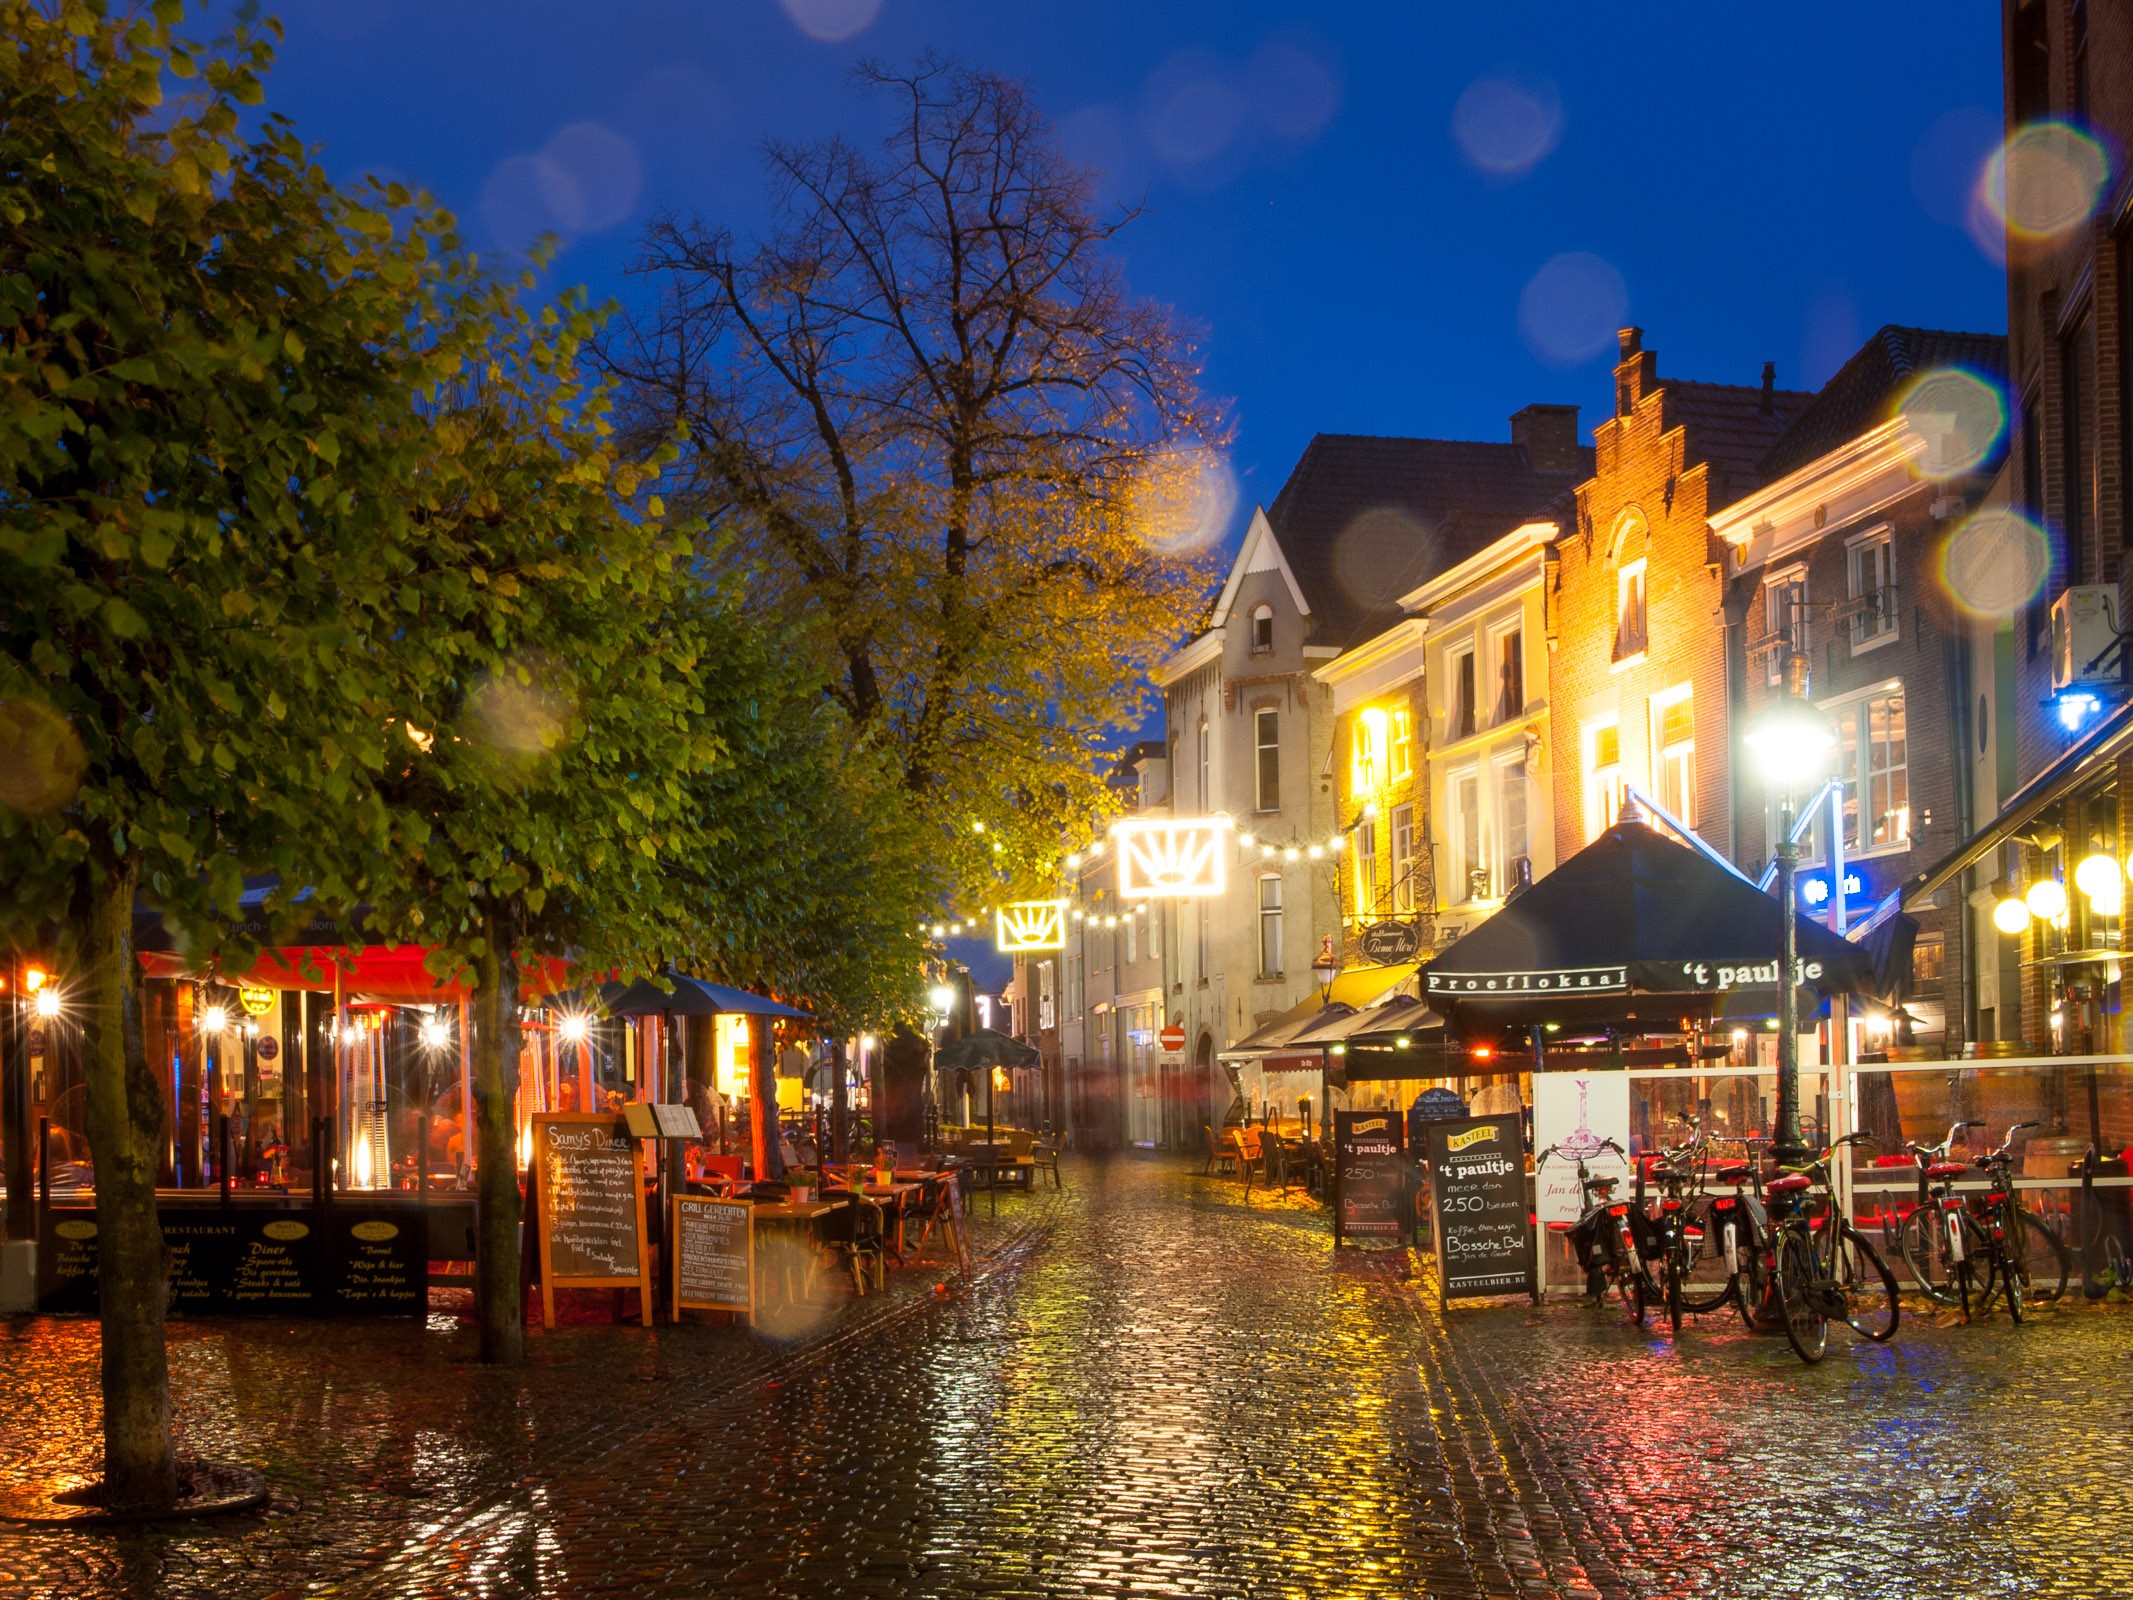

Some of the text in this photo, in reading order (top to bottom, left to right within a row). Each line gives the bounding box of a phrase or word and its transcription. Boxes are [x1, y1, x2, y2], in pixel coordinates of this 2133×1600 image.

[1429, 970, 1627, 990] Proeflokaal
[1717, 957, 1824, 990] paulje
[1355, 1120, 1384, 1132] KASTEEL
[548, 1126, 591, 1148] Samy's
[1452, 1127, 1493, 1148] KASTEEL
[1357, 1143, 1397, 1155] paultje
[1344, 1168, 1375, 1180] 250
[1457, 1160, 1515, 1180] paultje
[1482, 1181, 1503, 1190] dan
[1545, 1184, 1566, 1197] Jan
[681, 1201, 702, 1214] GRILL
[703, 1203, 747, 1218] GERECHTEN
[1442, 1196, 1484, 1213] 250
[249, 1242, 286, 1255] Diner
[1446, 1235, 1525, 1253] Bossche Bol
[378, 1260, 386, 1269] &
[273, 1278, 281, 1287] &
[1449, 1276, 1527, 1289] KASTEELBIER.BE
[379, 1289, 386, 1297] &
